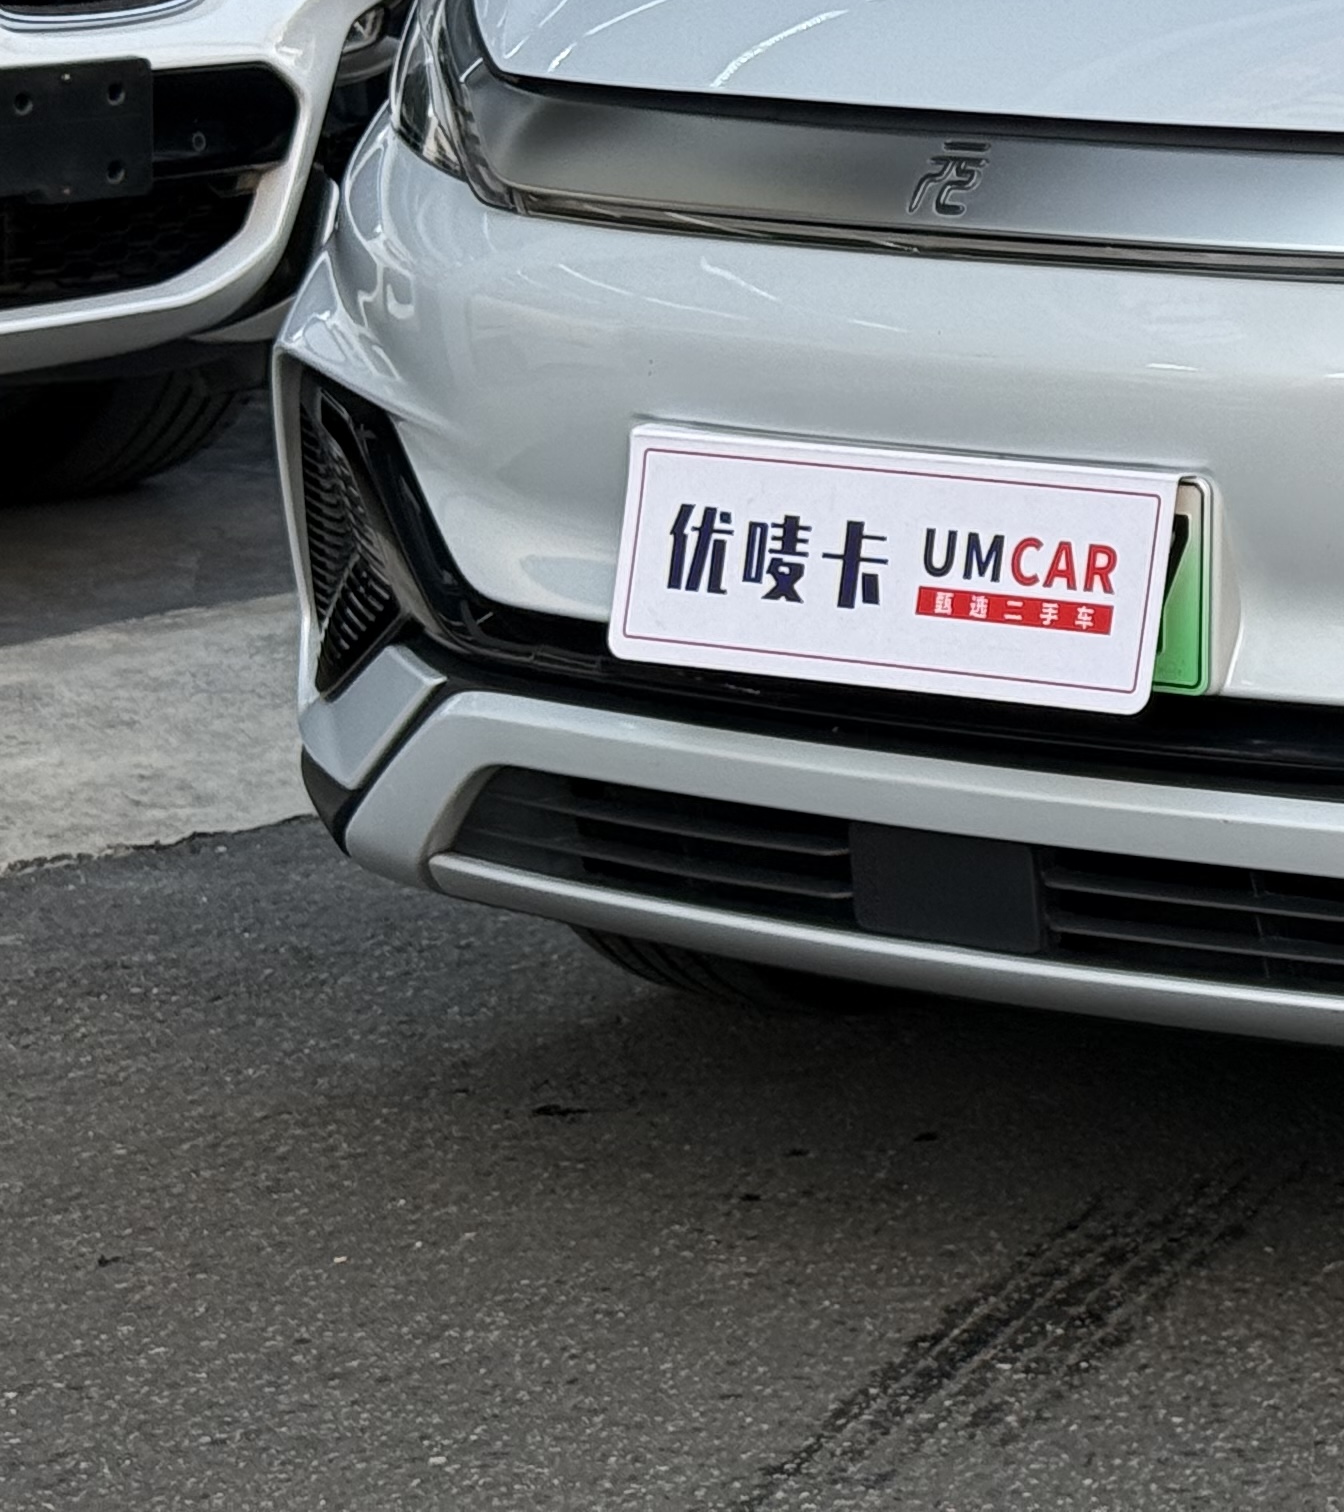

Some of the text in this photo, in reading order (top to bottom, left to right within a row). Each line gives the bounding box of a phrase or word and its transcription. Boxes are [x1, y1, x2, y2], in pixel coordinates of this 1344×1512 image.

[667, 503, 888, 609] 优唛卡
[923, 527, 1118, 595] UMCAR
